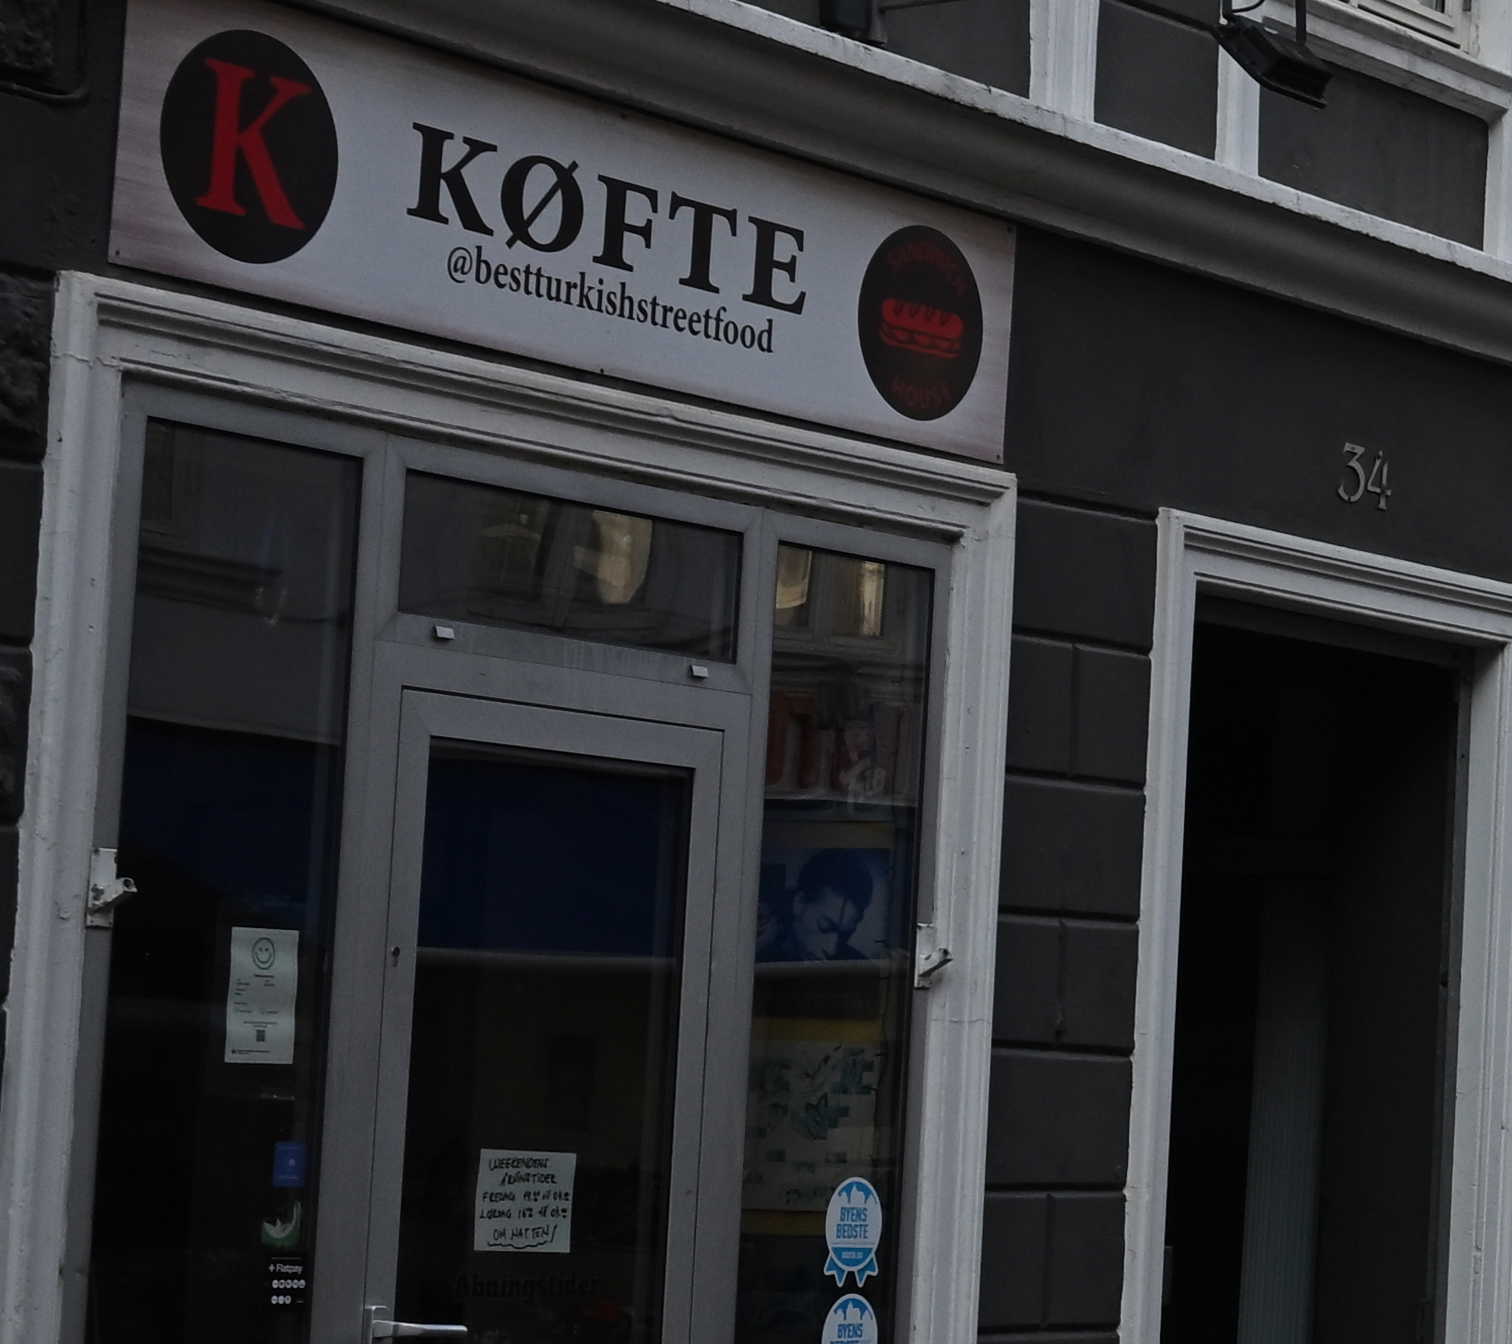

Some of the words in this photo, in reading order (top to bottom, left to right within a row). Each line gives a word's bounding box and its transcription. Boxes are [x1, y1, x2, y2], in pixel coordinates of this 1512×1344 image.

[197, 58, 313, 230] K
[406, 120, 809, 317] KØFTE
[446, 243, 776, 355] @bestturkishstreetfood
[1338, 442, 1392, 509] 34
[836, 1224, 869, 1239] BEDSTE
[840, 1207, 868, 1222] BYENS
[838, 1324, 864, 1338] BYENS
